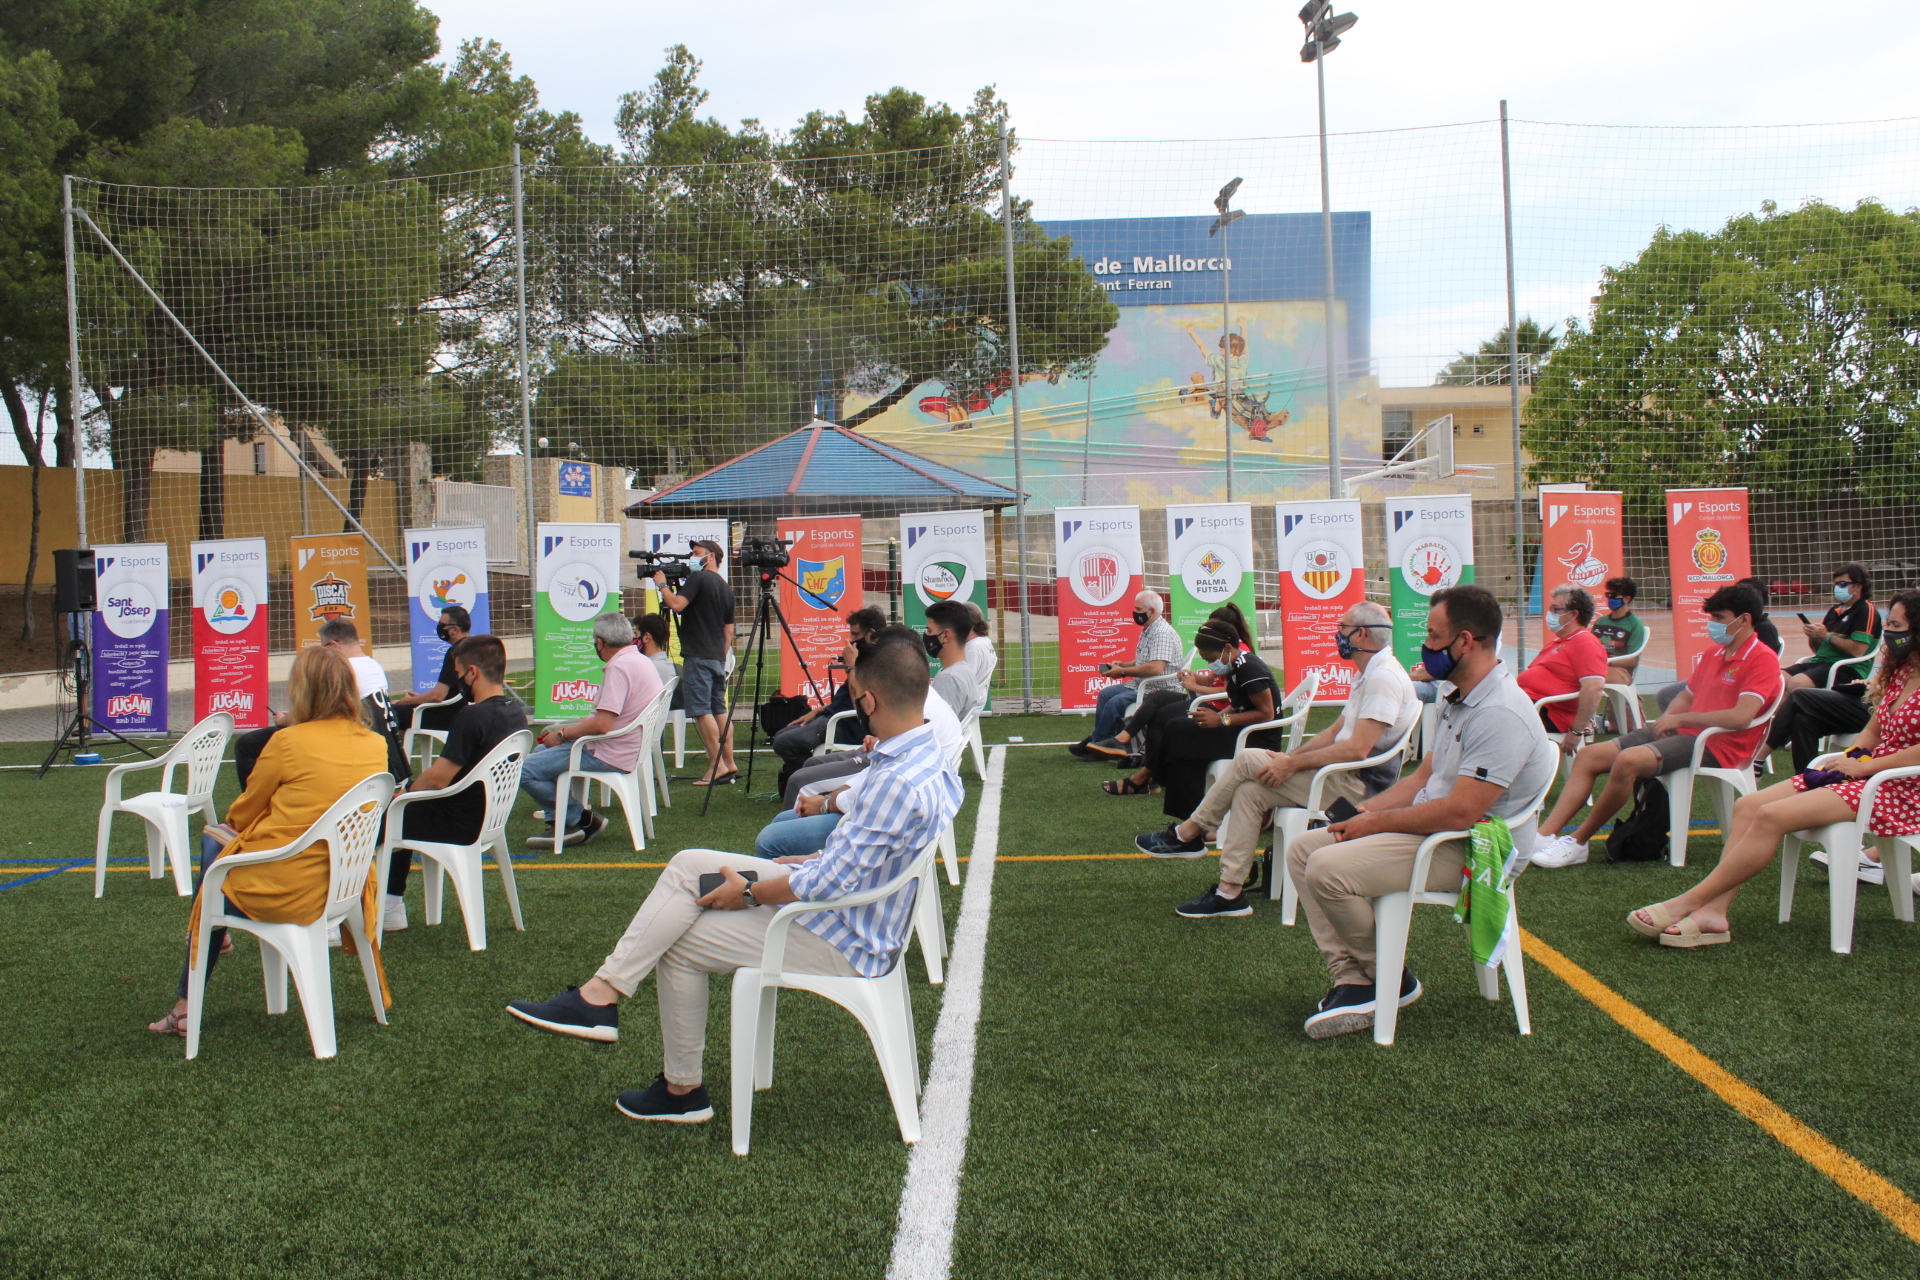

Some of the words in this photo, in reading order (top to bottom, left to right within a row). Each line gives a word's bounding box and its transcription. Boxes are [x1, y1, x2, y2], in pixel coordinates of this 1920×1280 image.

[1094, 257, 1122, 275] de
[1133, 254, 1232, 274] Mallorca
[1128, 279, 1172, 290] Ferran
[1574, 505, 1616, 518] Esports
[1698, 502, 1740, 515] Esports
[1310, 514, 1354, 526] Esports
[1420, 510, 1465, 522] Esports
[1089, 520, 1133, 532] Esports
[1200, 517, 1244, 529] Esports
[810, 530, 854, 542] Esports
[933, 525, 977, 538] Esports
[436, 540, 478, 552] Esports
[570, 536, 612, 549] Esports
[220, 552, 260, 564] Esports
[320, 547, 360, 560] Esports
[120, 556, 160, 568] Esports
[1592, 566, 1606, 575] CIDE
[806, 578, 827, 590] EHC
[316, 584, 345, 598] DISCA
[108, 597, 132, 607] Sant
[318, 597, 345, 606] ESPORTS
[118, 606, 150, 618] Josep
[1068, 664, 1096, 672] Creixem
[420, 680, 438, 688] Creix
[554, 682, 599, 700] JUGAM
[110, 696, 151, 714] JUGAM
[210, 692, 252, 712] JUGAM
